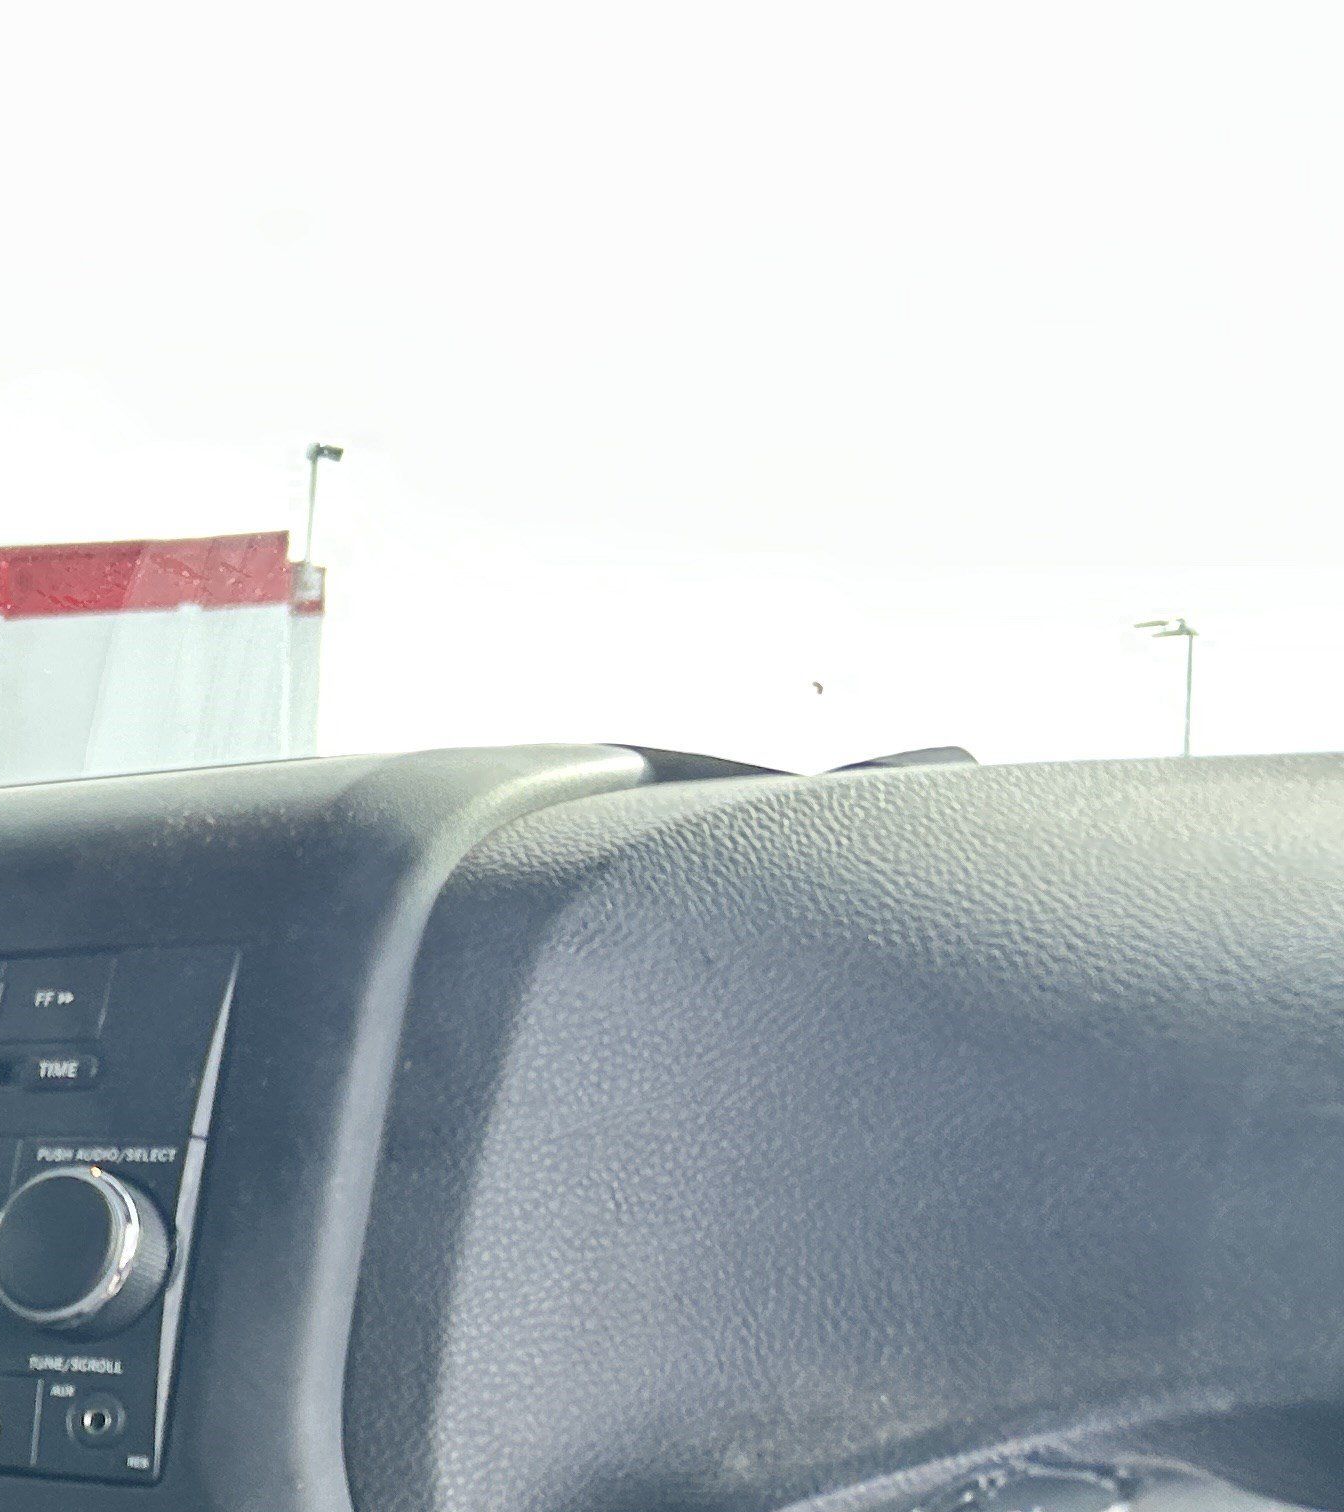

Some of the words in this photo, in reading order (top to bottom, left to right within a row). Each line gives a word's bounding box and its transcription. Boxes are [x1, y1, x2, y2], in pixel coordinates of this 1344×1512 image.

[34, 991, 54, 1007] FF
[39, 1059, 79, 1078] TIME
[37, 1149, 73, 1162] PUSH
